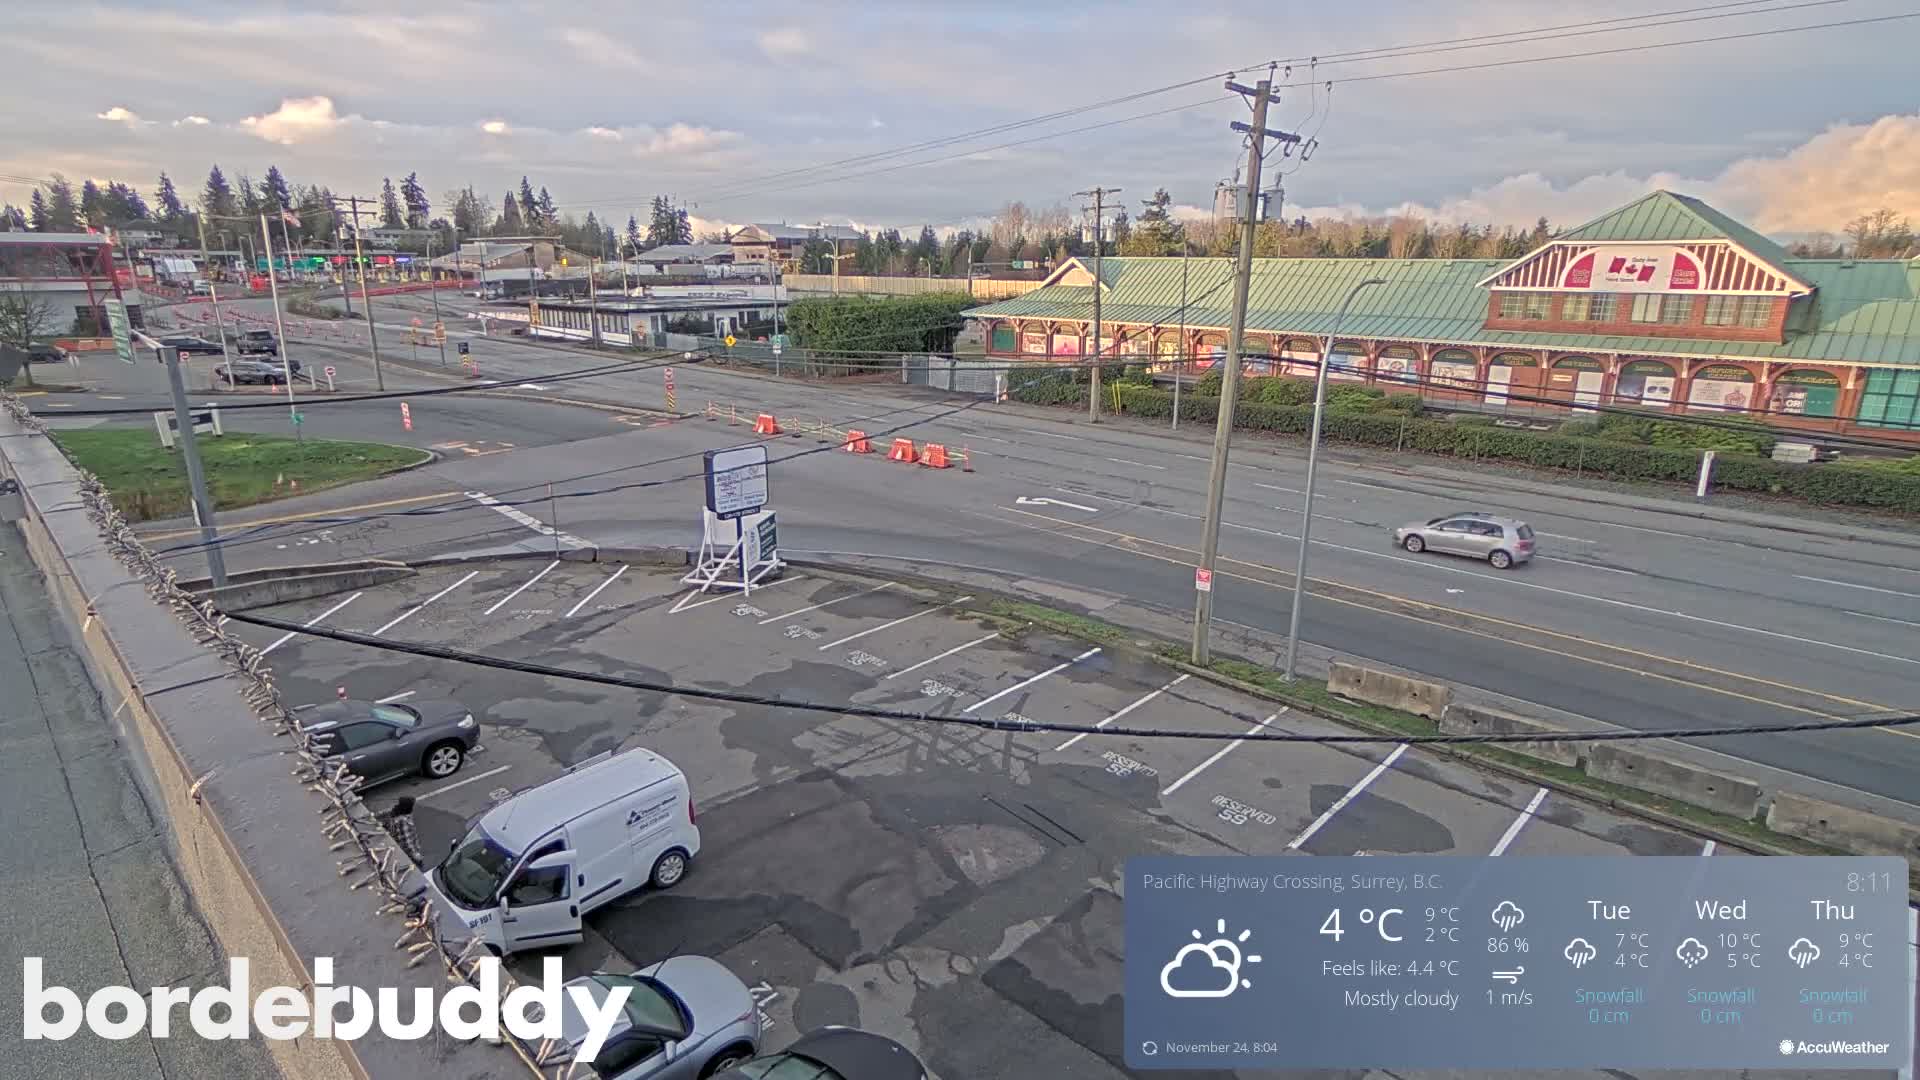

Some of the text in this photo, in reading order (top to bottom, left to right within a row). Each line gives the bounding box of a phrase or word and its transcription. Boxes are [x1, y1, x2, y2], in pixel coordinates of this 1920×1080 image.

[1101, 751, 1159, 777] RESERVED
[1211, 795, 1277, 825] RESERVED
[1218, 809, 1249, 825] 59
